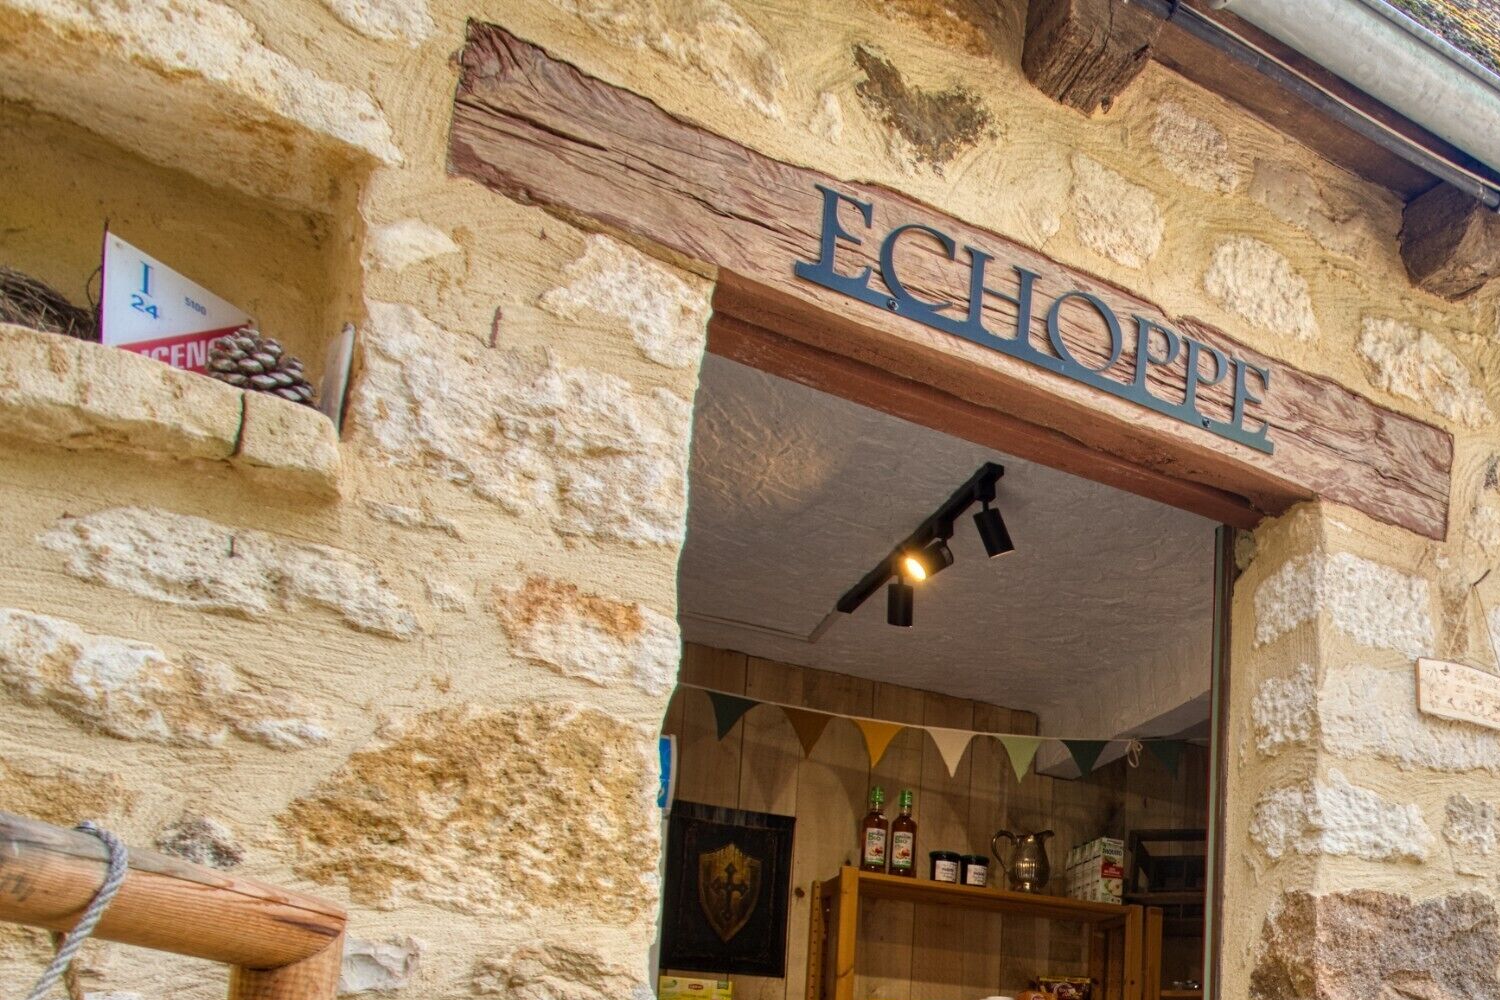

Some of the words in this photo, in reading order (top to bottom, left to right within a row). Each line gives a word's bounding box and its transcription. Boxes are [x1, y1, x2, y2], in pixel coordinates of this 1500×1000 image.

[130, 292, 160, 321] 24
[795, 184, 1274, 454] ECHOPPE
[140, 338, 217, 369] CEN
